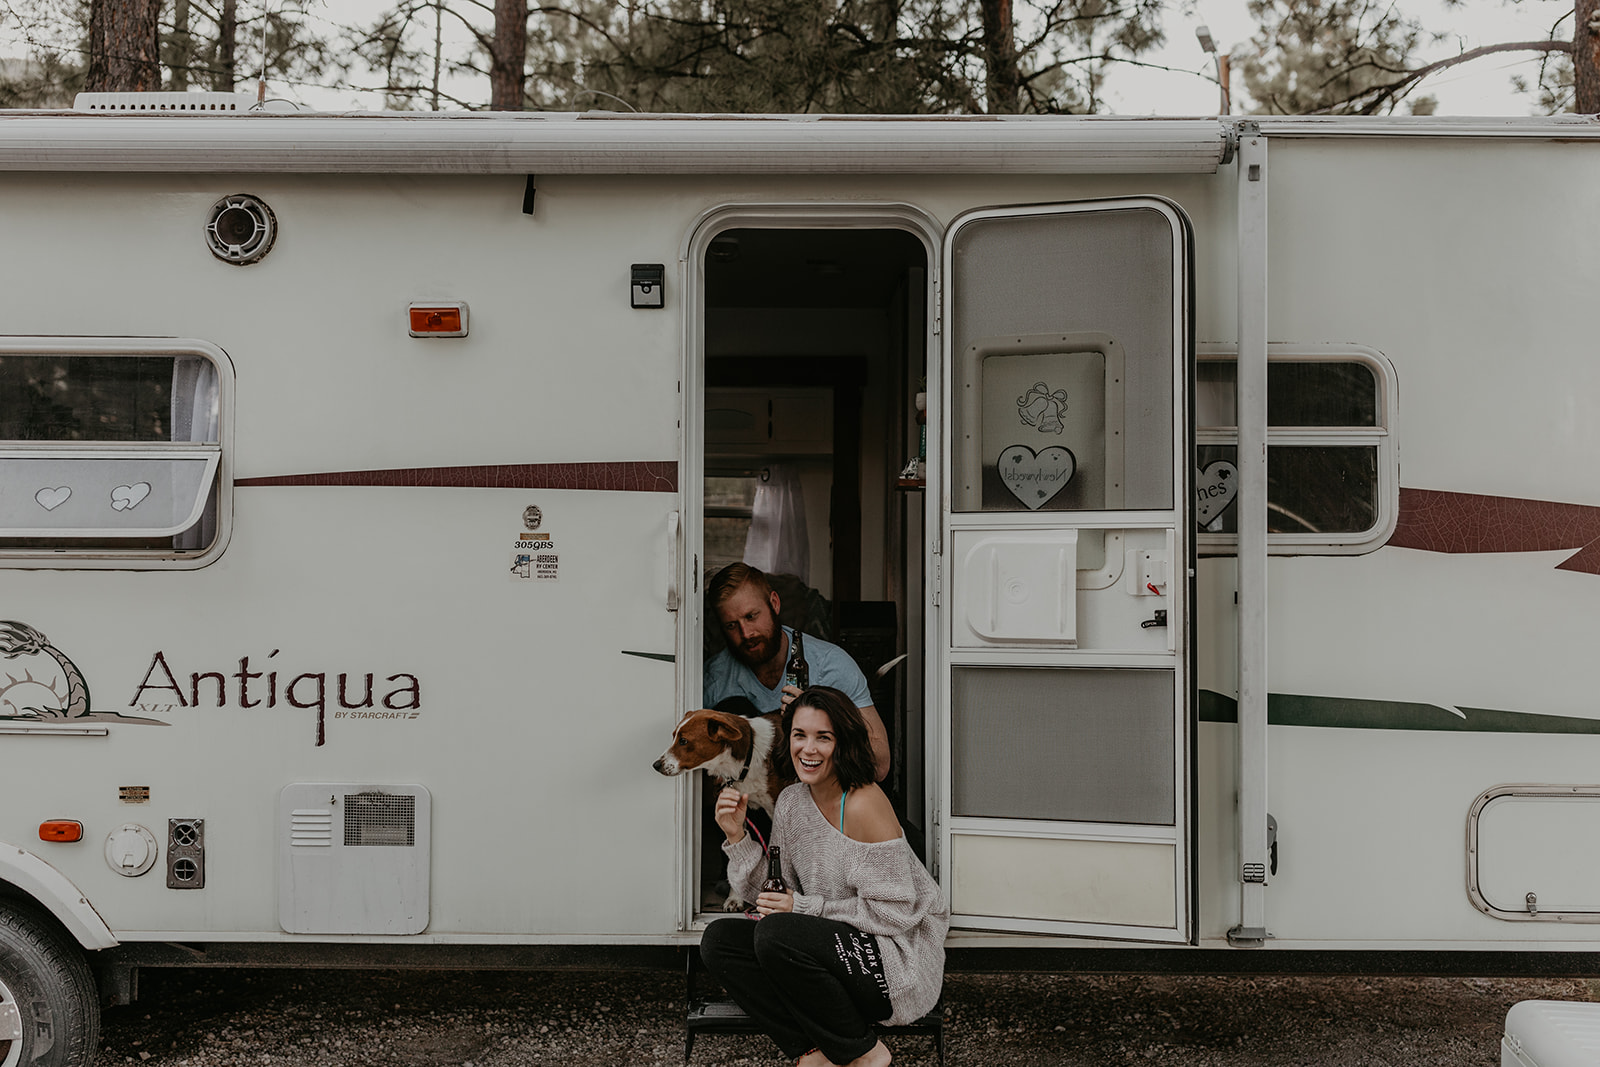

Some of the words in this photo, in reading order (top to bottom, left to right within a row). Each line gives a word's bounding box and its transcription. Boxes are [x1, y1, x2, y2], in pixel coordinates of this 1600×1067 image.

[514, 541, 554, 551] 305QBS
[536, 554, 558, 563] ABERDEEN
[135, 703, 178, 713] XLT
[334, 711, 349, 719] BY
[349, 711, 409, 720] STARCRAFT
[863, 942, 878, 968] YORK
